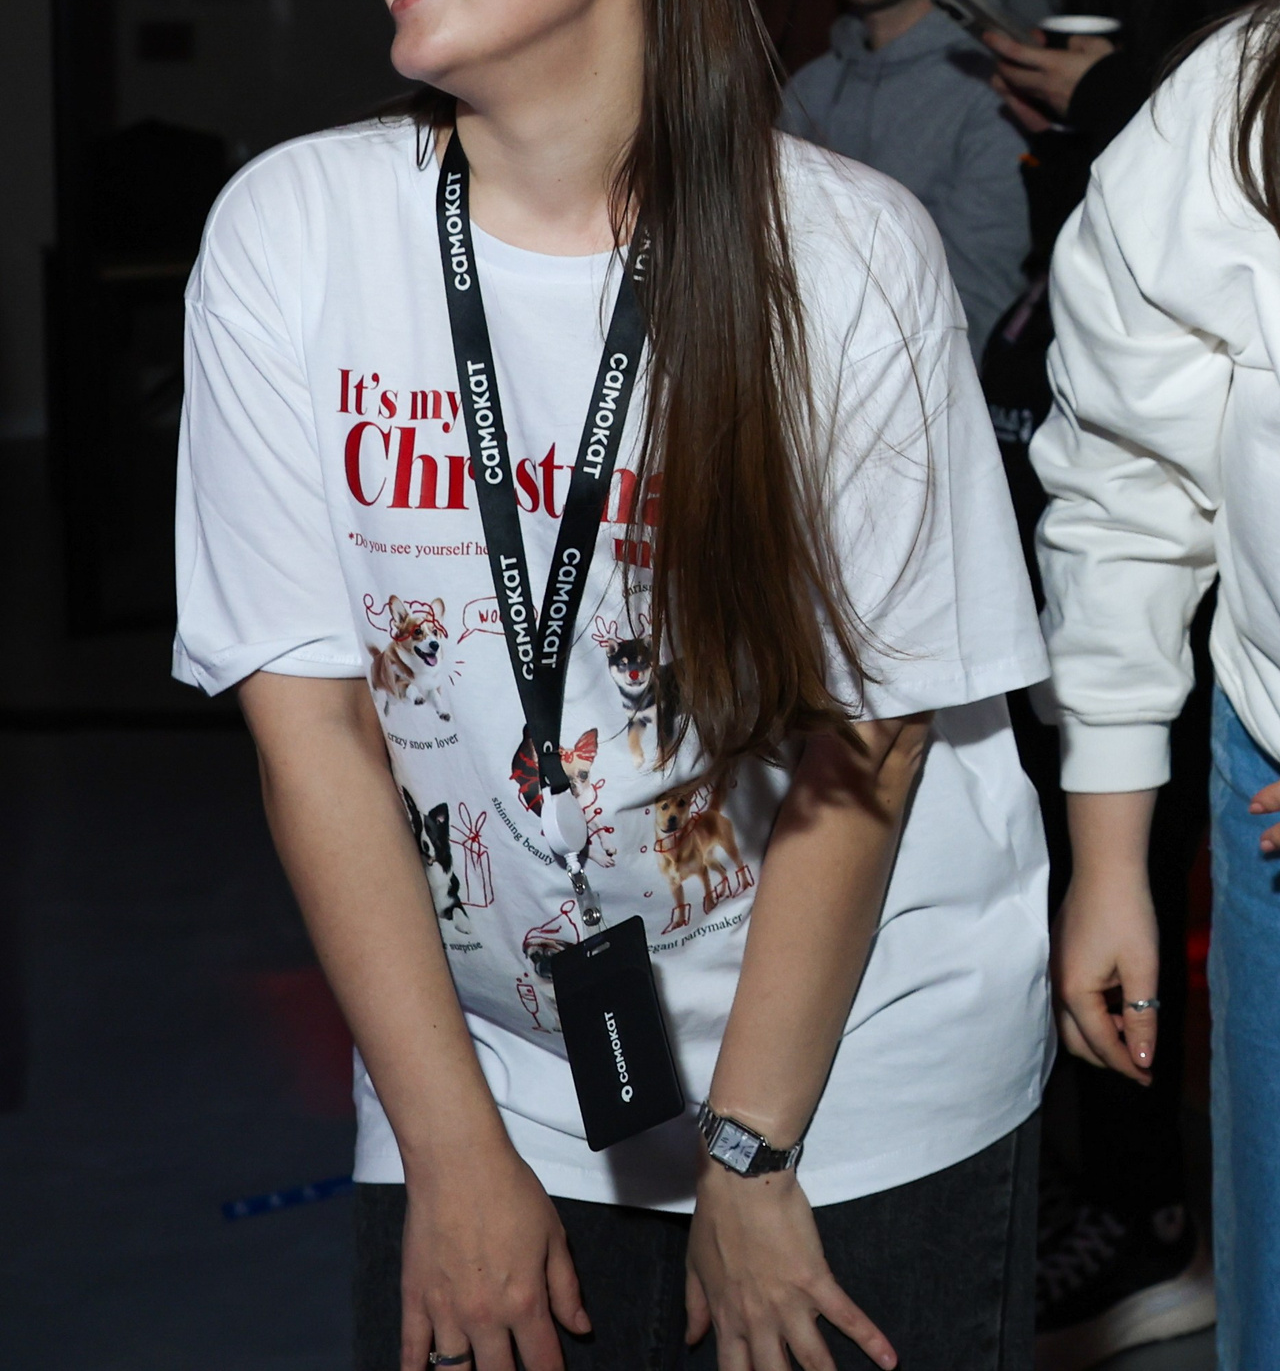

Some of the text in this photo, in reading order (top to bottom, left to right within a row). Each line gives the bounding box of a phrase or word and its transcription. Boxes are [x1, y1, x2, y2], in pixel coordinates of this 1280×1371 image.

[444, 172, 471, 291] самокат
[336, 368, 463, 433] It's my
[467, 360, 503, 485] самокат
[583, 352, 628, 479] самокат
[368, 540, 387, 553] you
[390, 542, 412, 555] see
[415, 542, 472, 558] yourself
[541, 547, 581, 669] самокат
[410, 739, 434, 751] snow
[436, 732, 460, 749] lover
[491, 796, 556, 866] shinning beauty
[681, 913, 743, 946] partymaker
[604, 1011, 629, 1083] самокат
